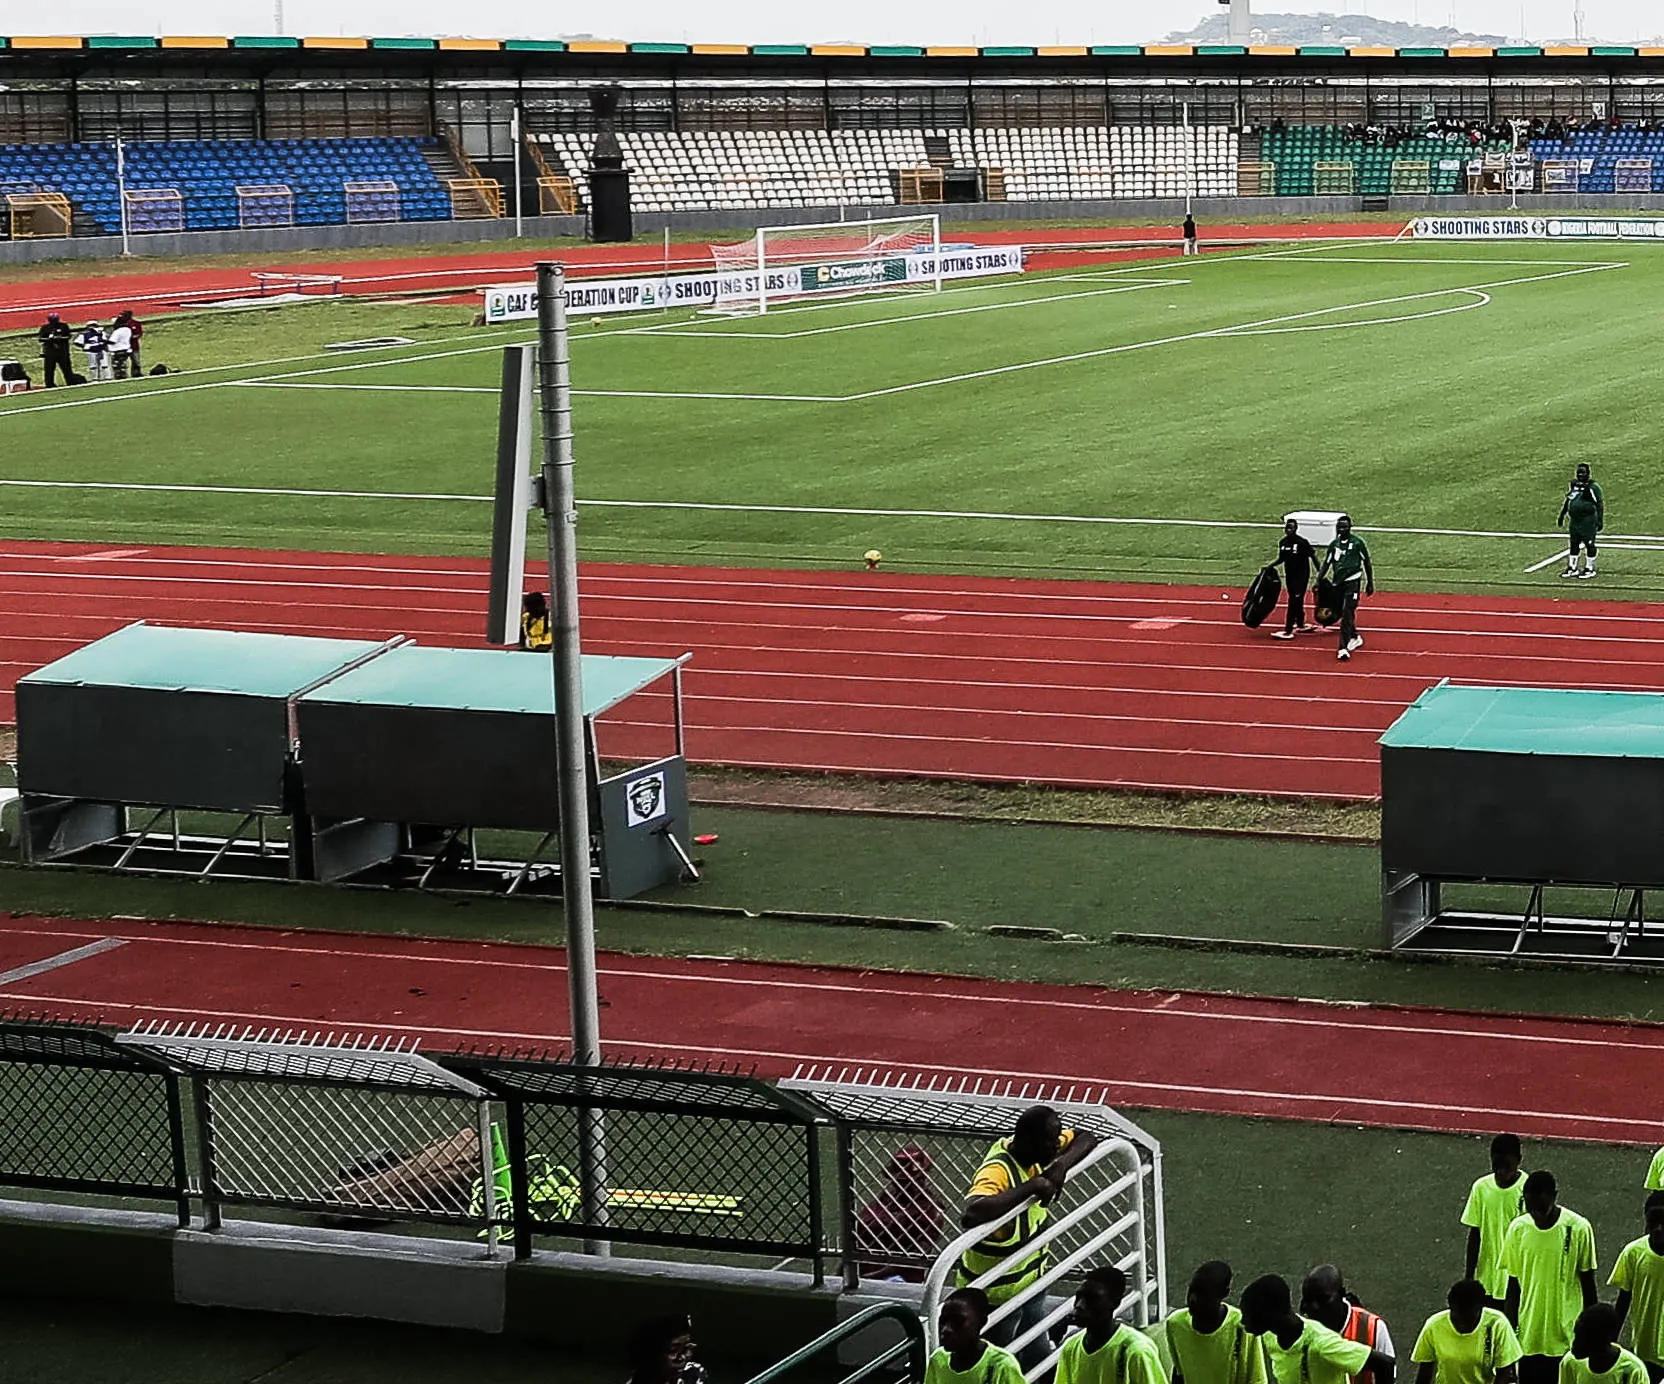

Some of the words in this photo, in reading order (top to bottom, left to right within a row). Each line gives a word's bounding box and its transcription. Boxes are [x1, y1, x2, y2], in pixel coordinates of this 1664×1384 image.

[1431, 220, 1490, 235] SHOOTING
[1492, 220, 1528, 235] STARS
[976, 253, 1008, 269] STARS
[618, 286, 639, 305] CUP
[675, 278, 742, 299] SHOOTING
